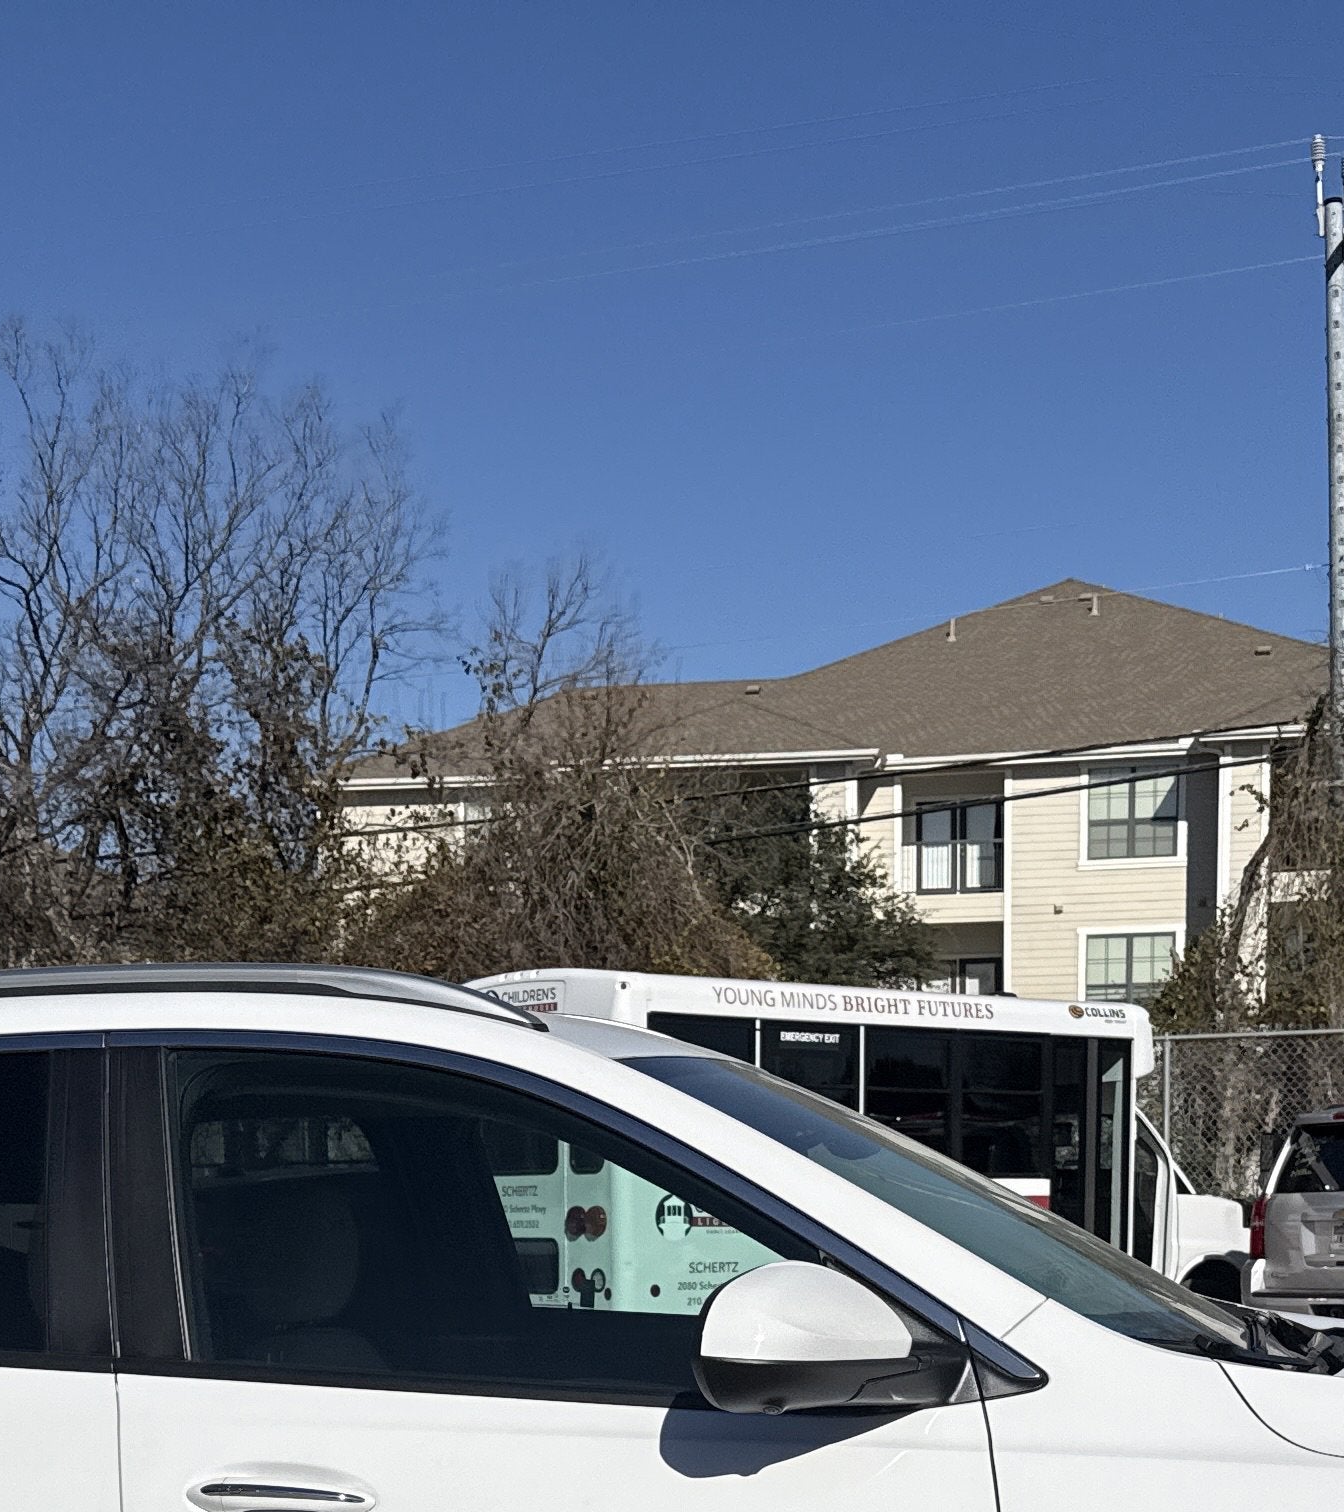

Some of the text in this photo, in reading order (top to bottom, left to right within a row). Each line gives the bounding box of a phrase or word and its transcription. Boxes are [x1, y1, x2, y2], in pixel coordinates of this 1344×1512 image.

[712, 986, 994, 1020] YOUNG MINDS BRIGHT FUTURES
[1085, 1007, 1126, 1019] COLLINS
[688, 1261, 740, 1274] SCHERTZ
